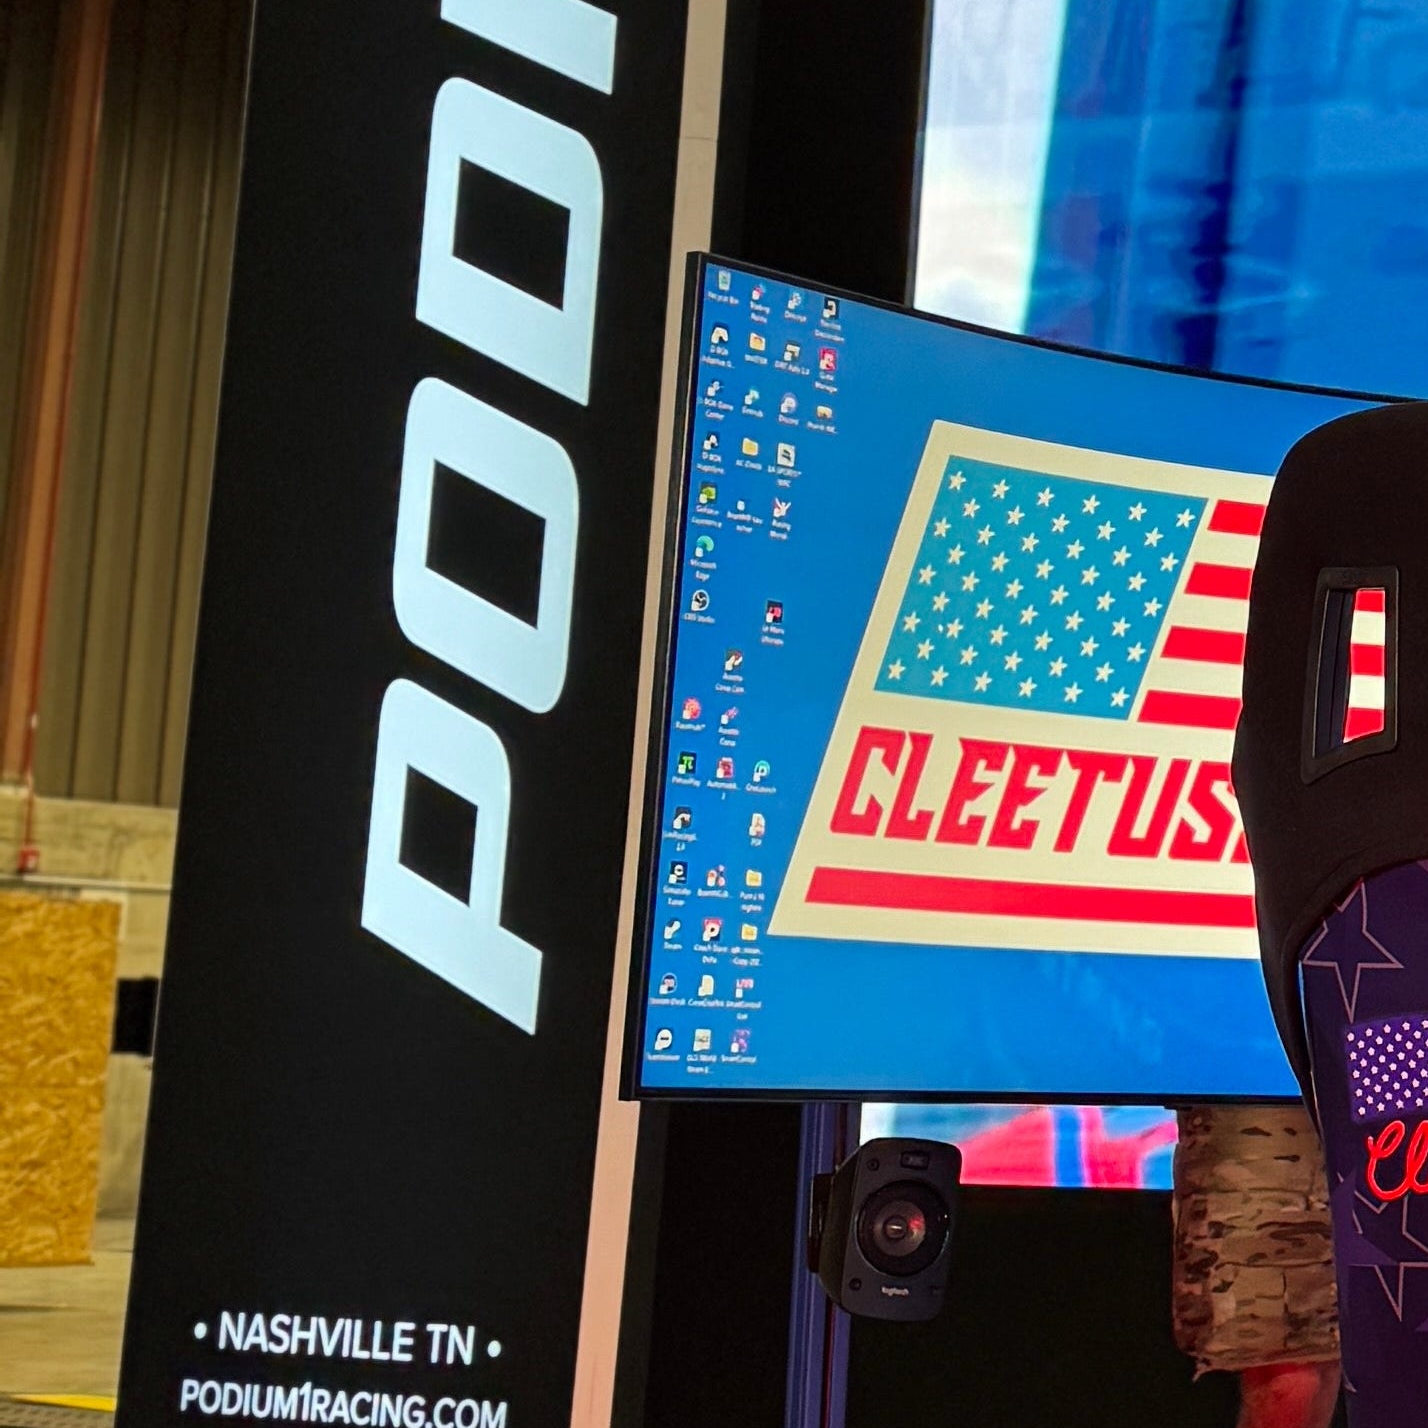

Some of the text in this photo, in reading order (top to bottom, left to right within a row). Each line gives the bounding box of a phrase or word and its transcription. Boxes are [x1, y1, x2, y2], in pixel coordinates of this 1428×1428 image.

[830, 725, 1236, 863] CLEETUS
[218, 1311, 476, 1365] NASHVILLE TN
